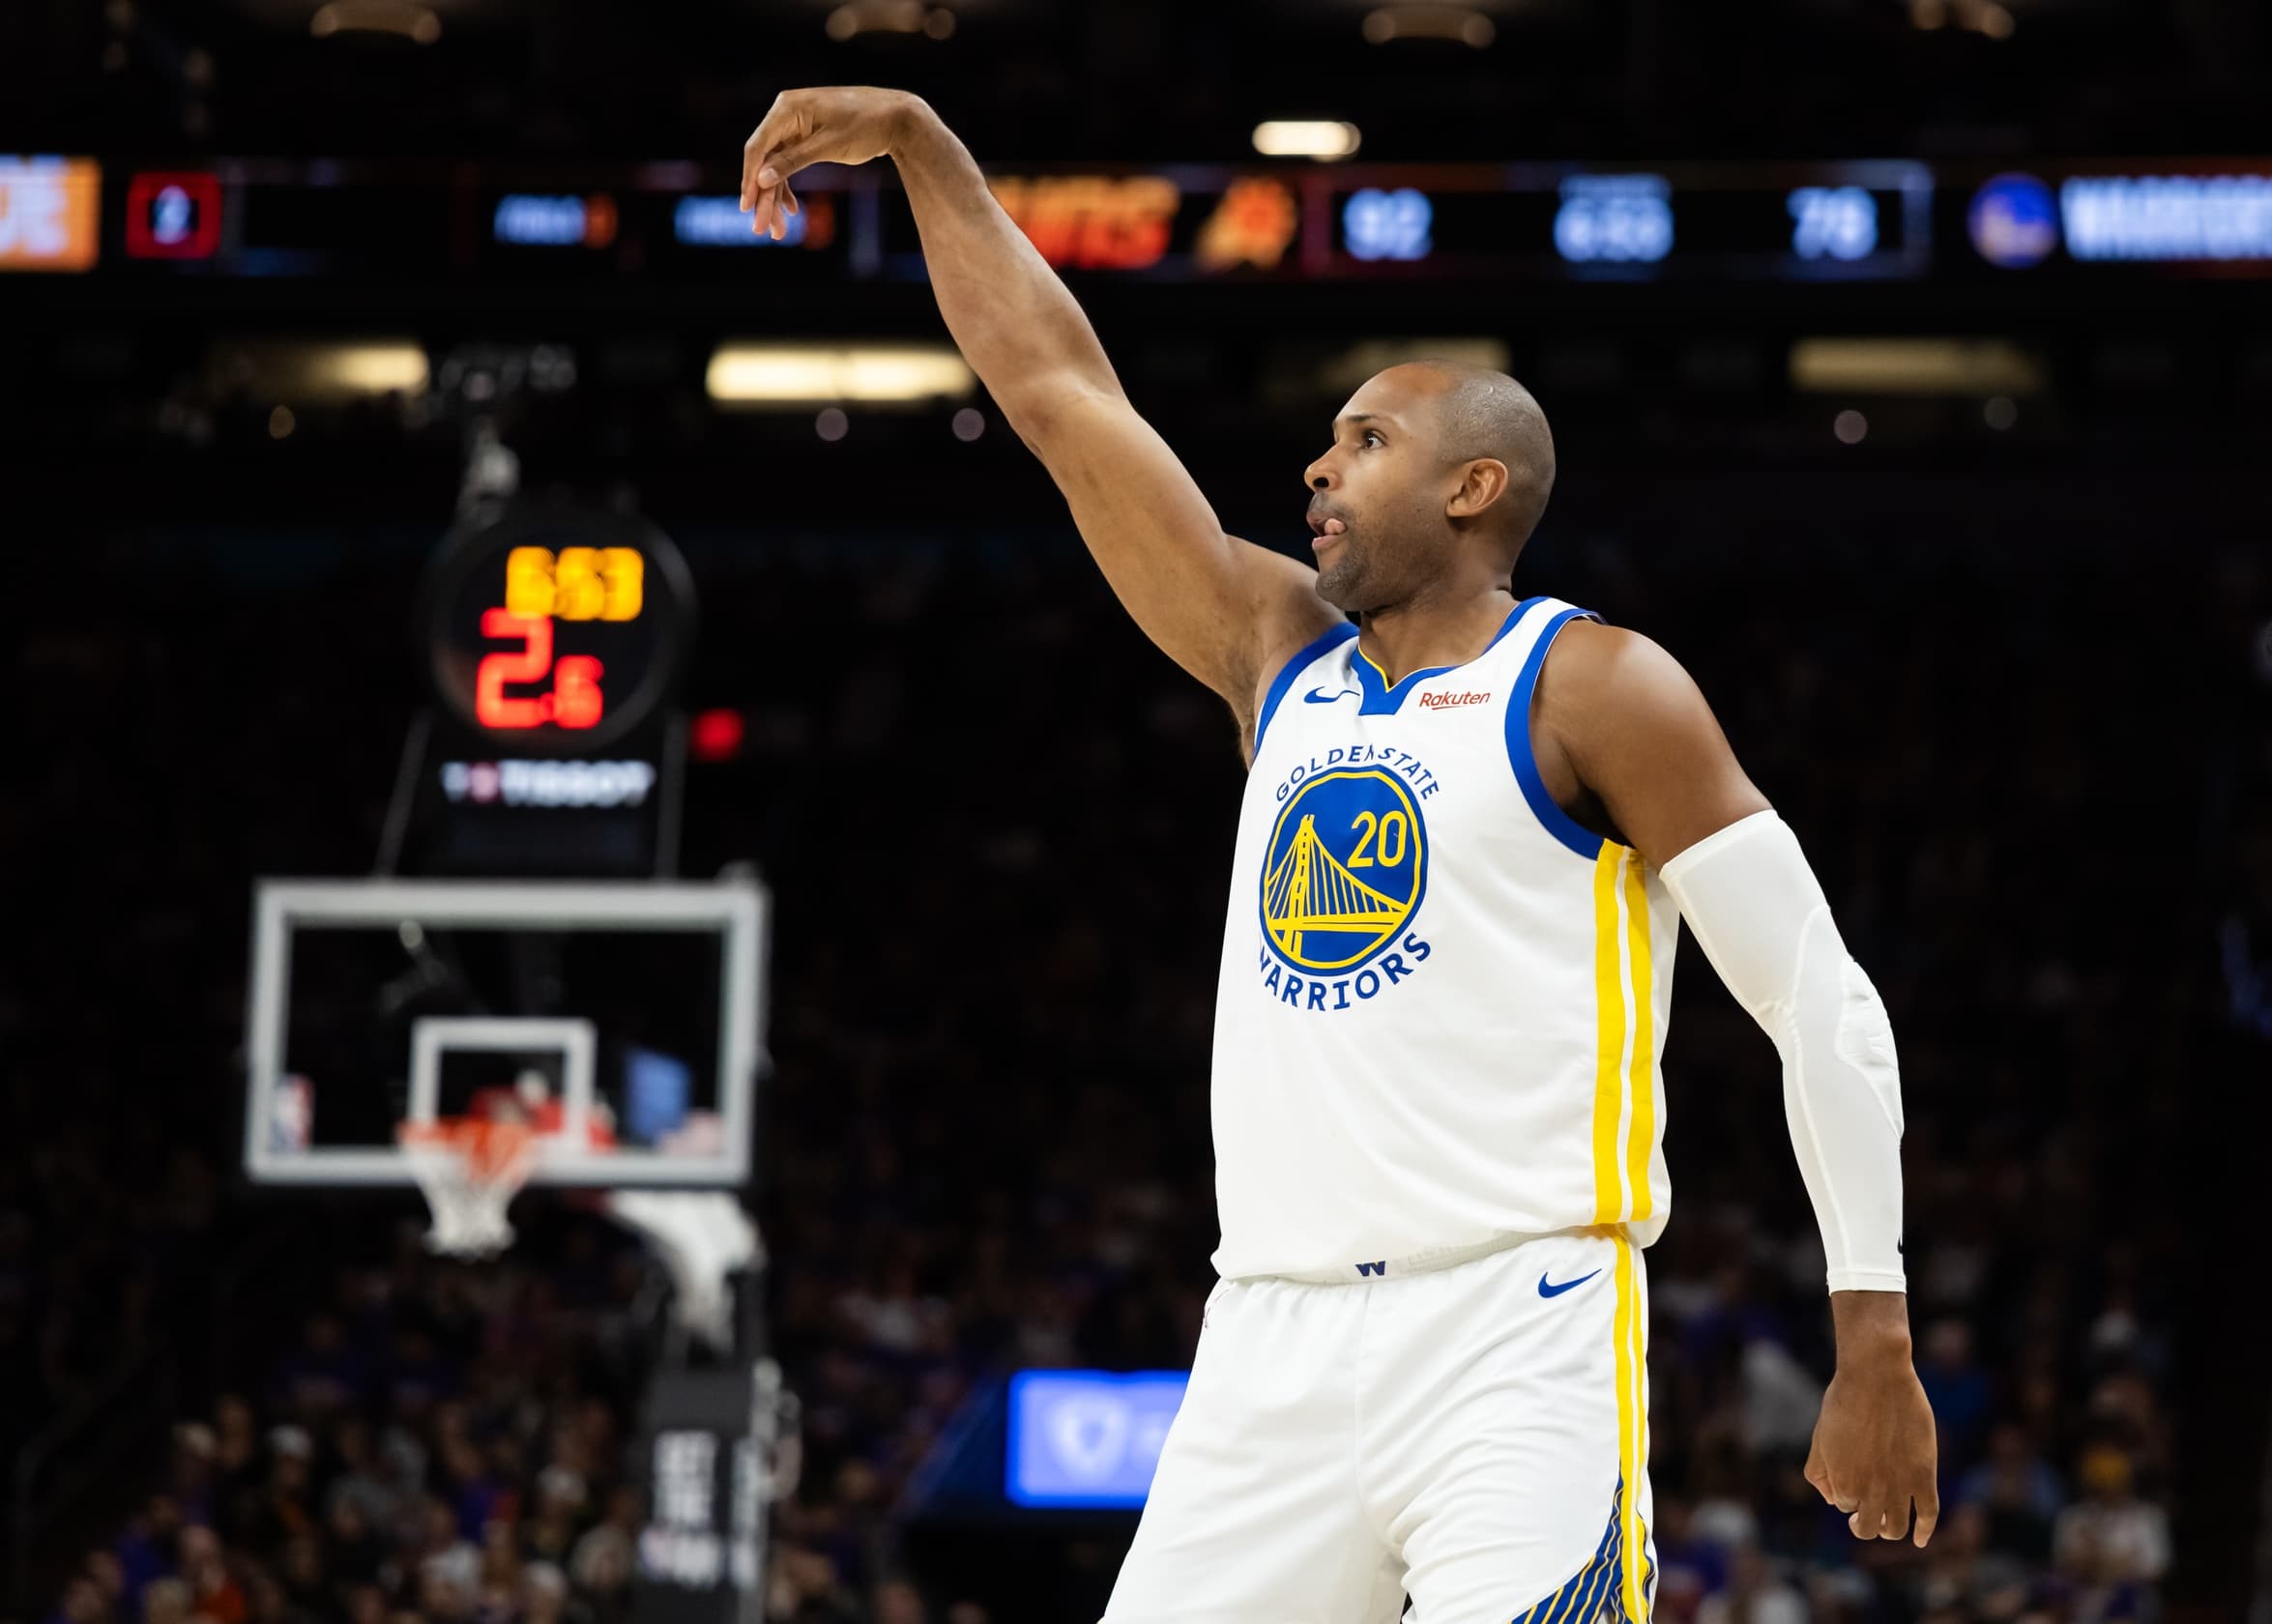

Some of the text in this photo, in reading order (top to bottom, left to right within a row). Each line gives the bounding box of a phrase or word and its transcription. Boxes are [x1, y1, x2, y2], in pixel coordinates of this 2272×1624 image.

[1787, 187, 1878, 260] 78
[1419, 690, 1491, 710] Rakuten
[1378, 747, 1439, 800] STATE
[1347, 810, 1408, 868] 20
